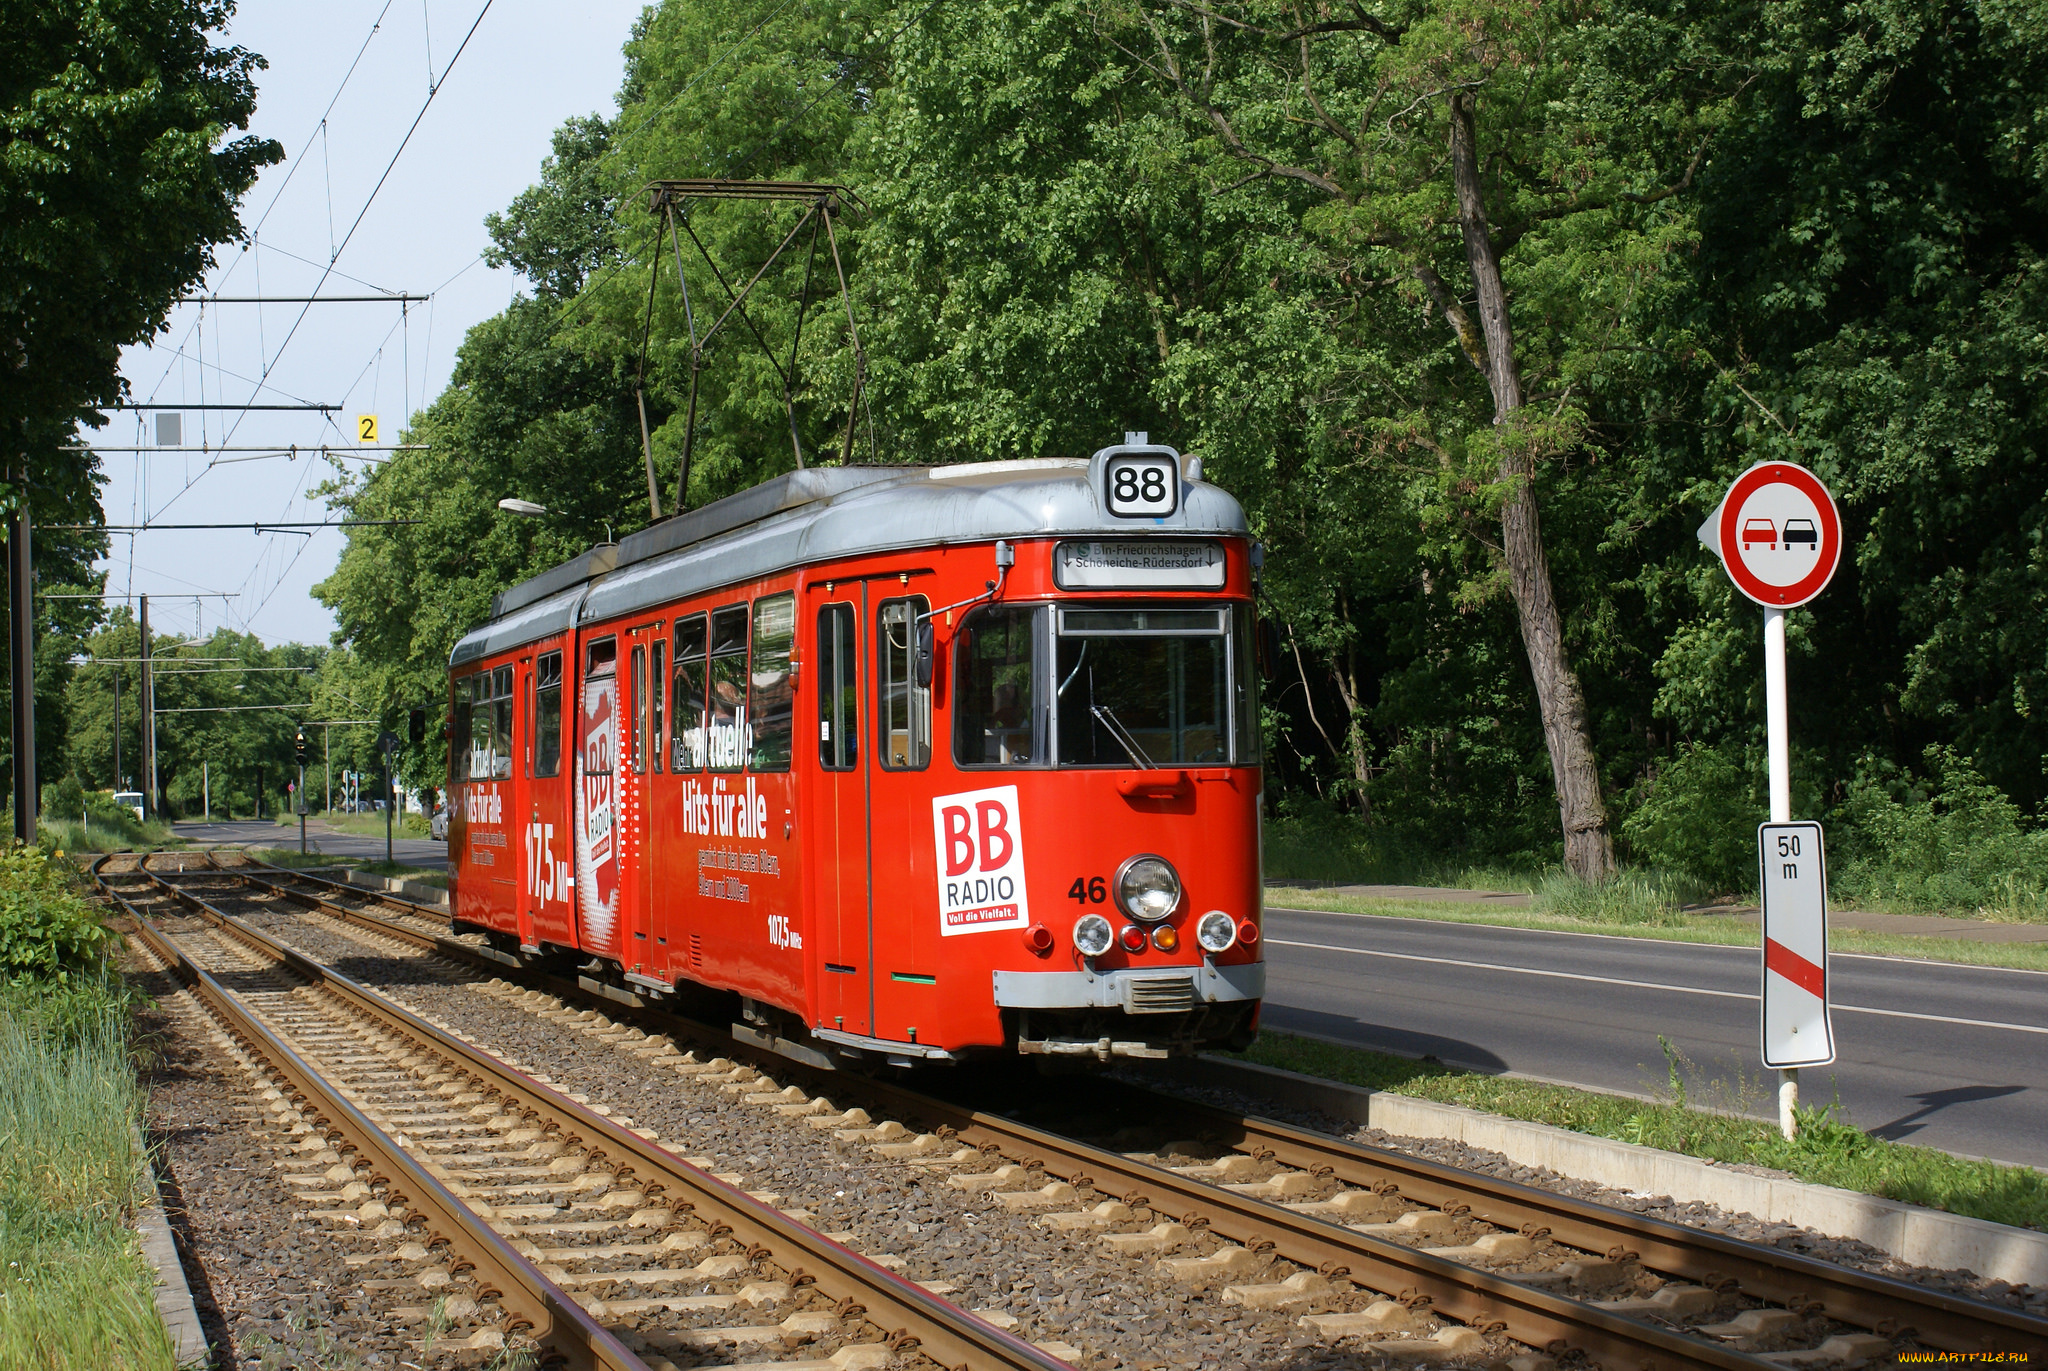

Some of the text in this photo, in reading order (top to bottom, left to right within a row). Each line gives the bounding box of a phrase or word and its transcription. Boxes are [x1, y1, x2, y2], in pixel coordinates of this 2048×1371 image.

[361, 418, 374, 439] 2
[1114, 467, 1166, 502] 88
[1076, 557, 1203, 568] Schöneiche-Rüdersdorf
[1094, 544, 1202, 557] Bln-Friedrichshagen
[589, 733, 608, 812] BB
[477, 783, 489, 824] für
[489, 783, 502, 824] alle
[682, 776, 767, 839] Hits für alle
[590, 807, 609, 843] RADIO
[941, 799, 1013, 877] BB
[1777, 834, 1801, 857] 50
[1783, 863, 1797, 879] m
[947, 876, 1014, 907] RADIO
[1068, 876, 1107, 905] 46
[948, 907, 1016, 924] Voll die Vielfalt.
[767, 914, 802, 950] 107,5 MHz
